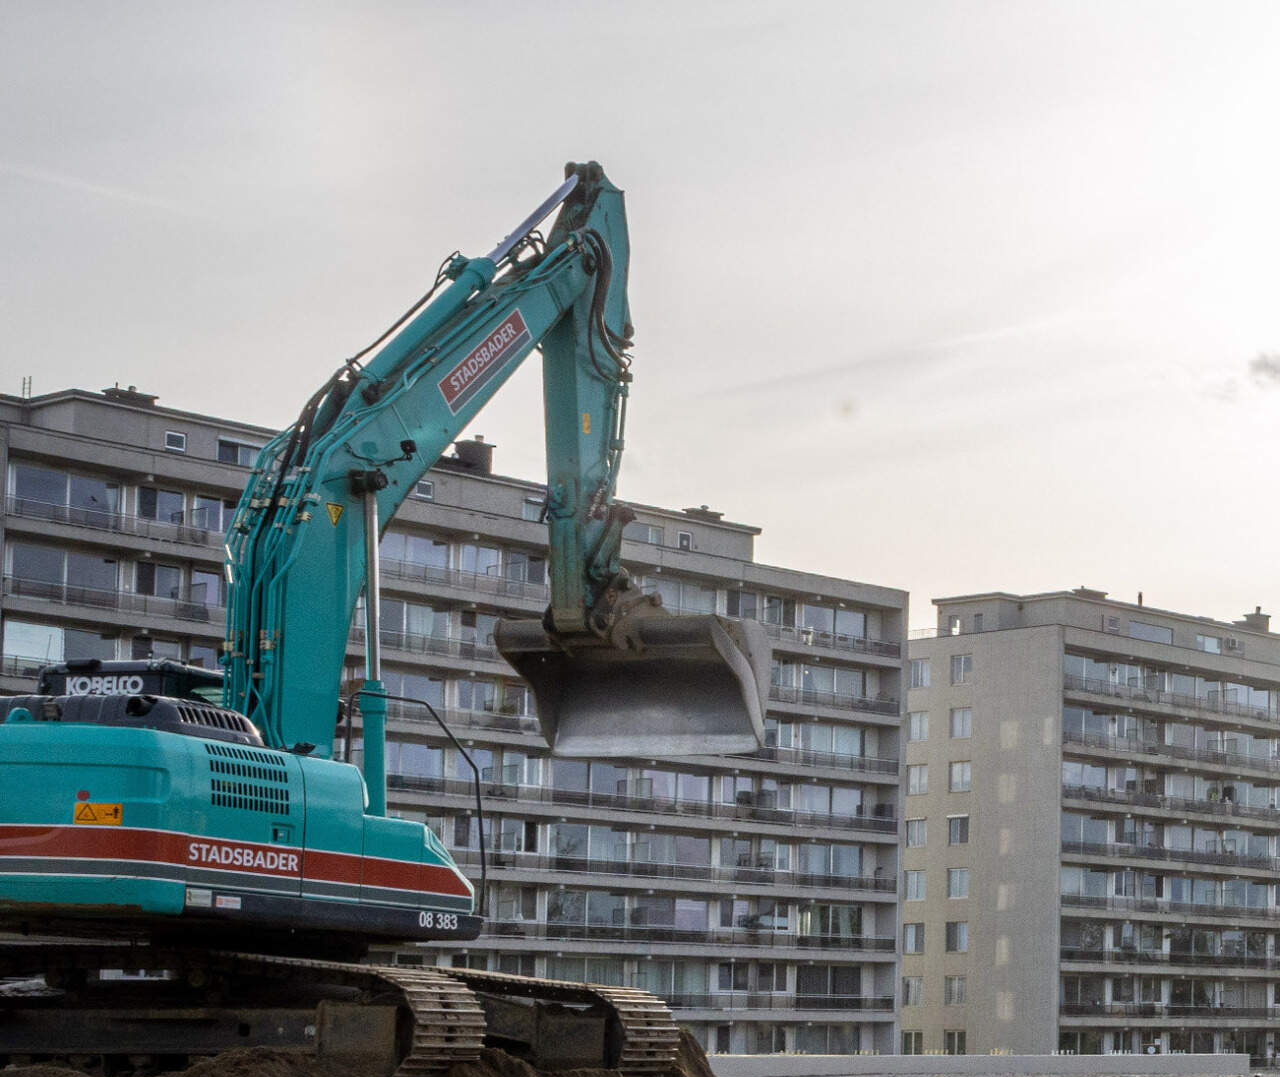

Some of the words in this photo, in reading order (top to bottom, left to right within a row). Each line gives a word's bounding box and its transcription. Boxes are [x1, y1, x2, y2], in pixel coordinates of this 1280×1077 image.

[450, 322, 517, 392] STADSBADER
[65, 675, 144, 697] KOBELCO
[188, 842, 299, 872] STADSBADER
[419, 911, 434, 928] 08
[436, 913, 458, 930] 383
